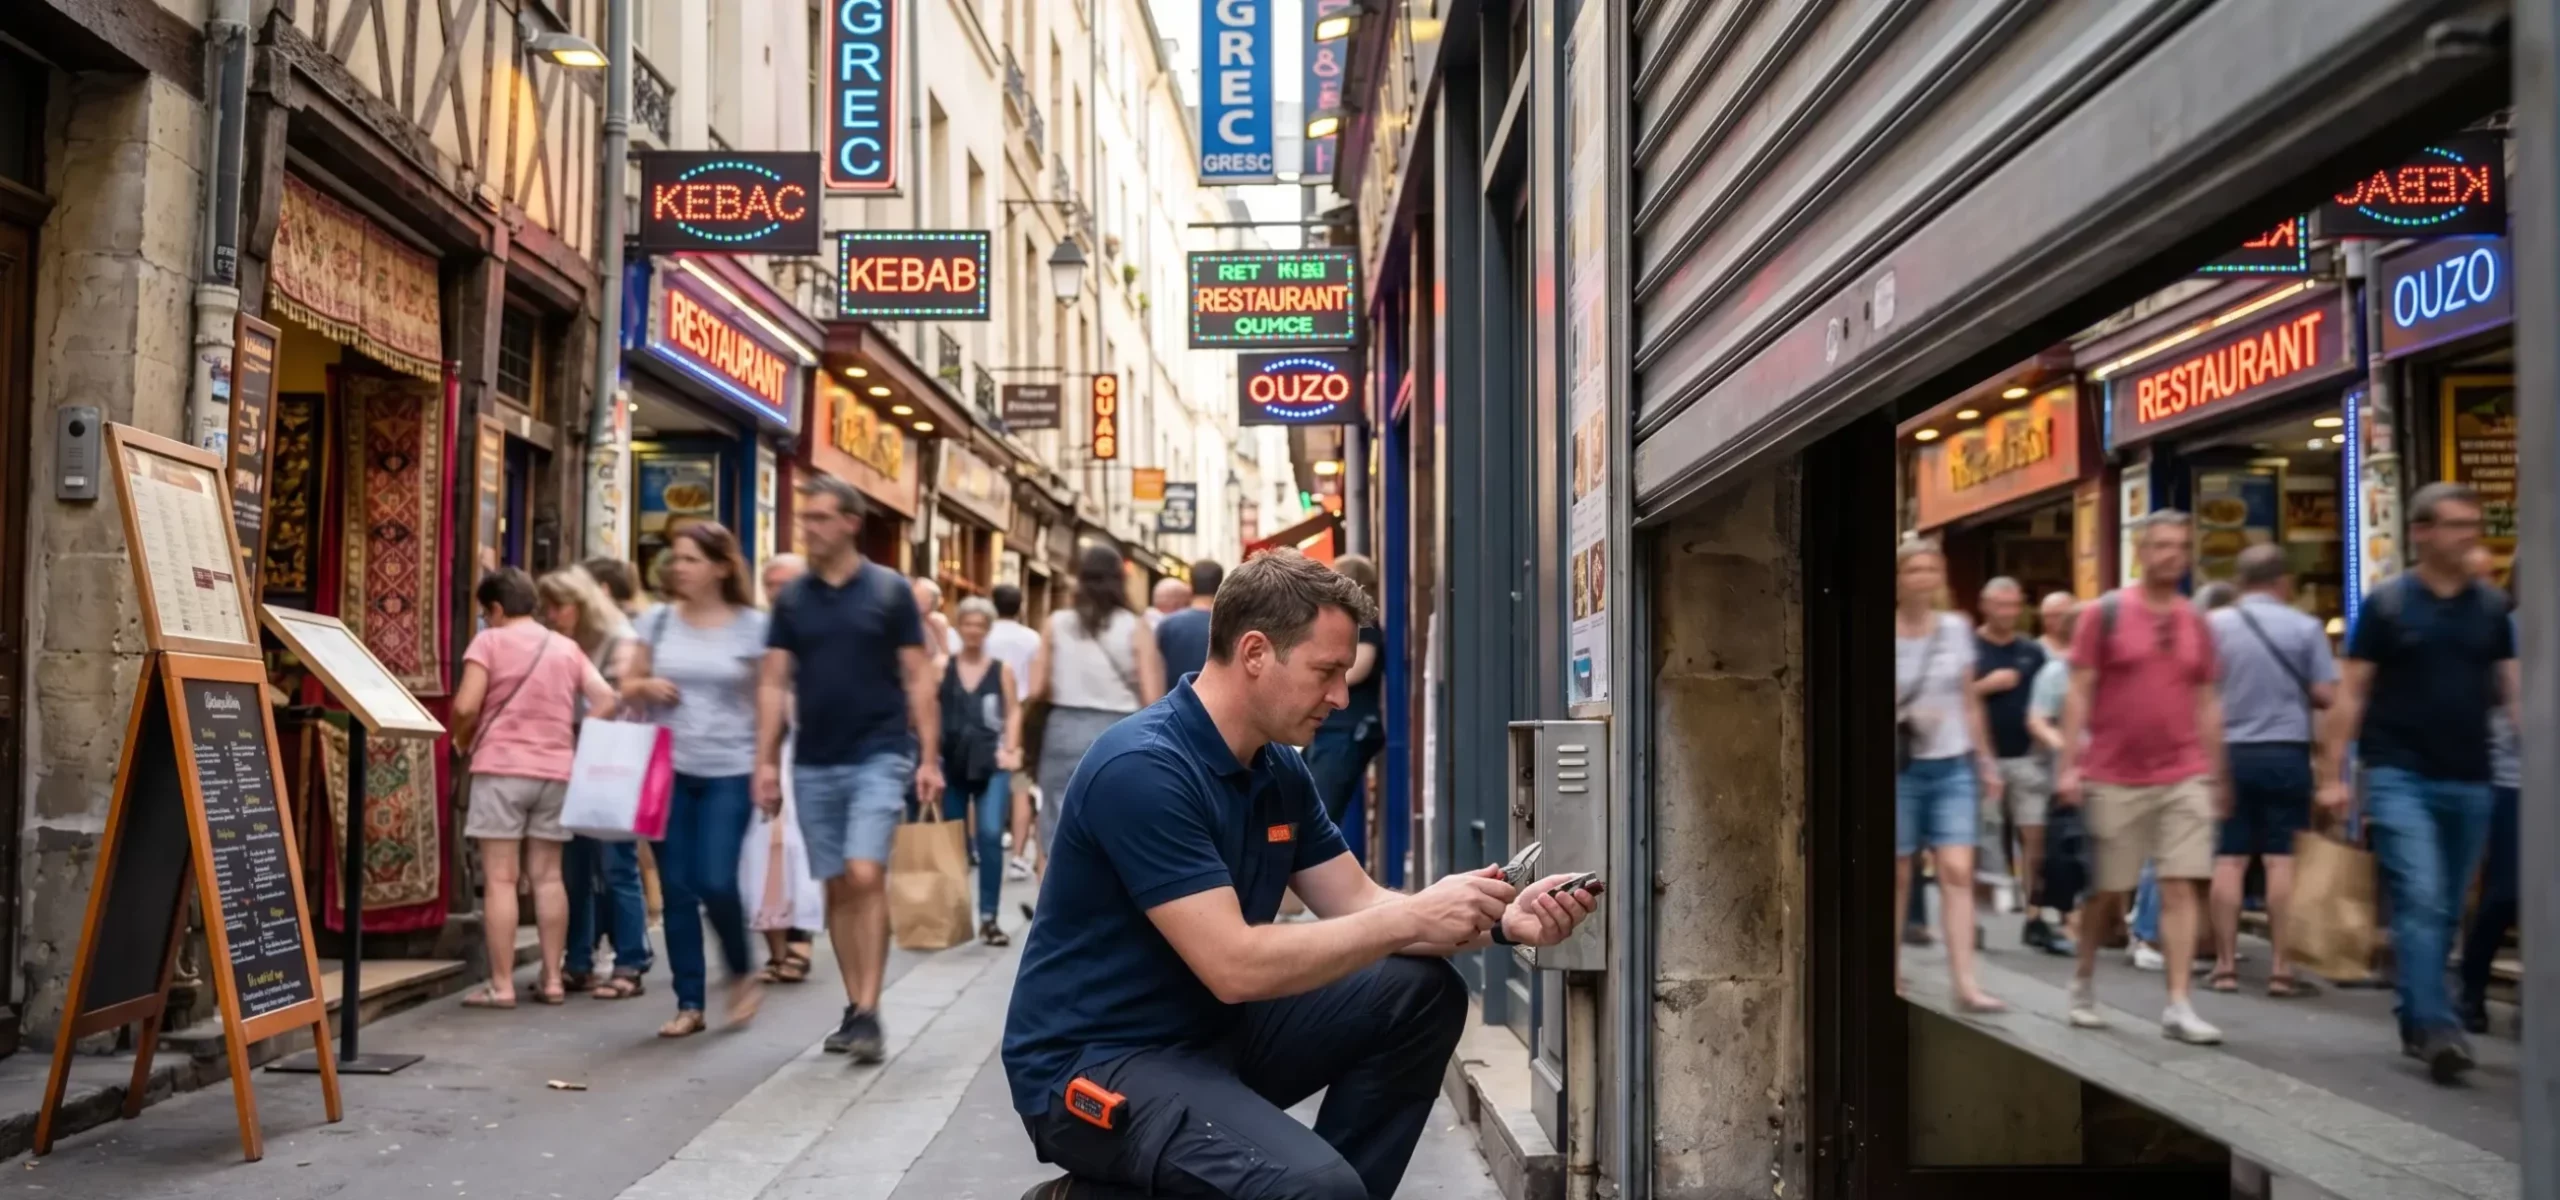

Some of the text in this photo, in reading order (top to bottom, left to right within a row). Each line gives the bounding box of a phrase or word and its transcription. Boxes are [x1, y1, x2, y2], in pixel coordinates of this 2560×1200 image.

[840, 0, 883, 176] GREC
[1216, 0, 1256, 145] GREC
[1203, 153, 1271, 172] GRESC
[654, 184, 806, 221] KEBAC
[849, 257, 977, 293] KEBAB
[1218, 264, 1261, 281] RET
[2393, 247, 2496, 328] OUZO
[1198, 285, 1348, 312] RESTAURANT
[668, 289, 786, 406] RESTAURANT
[2136, 311, 2323, 424] RESTAURANT
[1249, 374, 1350, 403] OUZO
